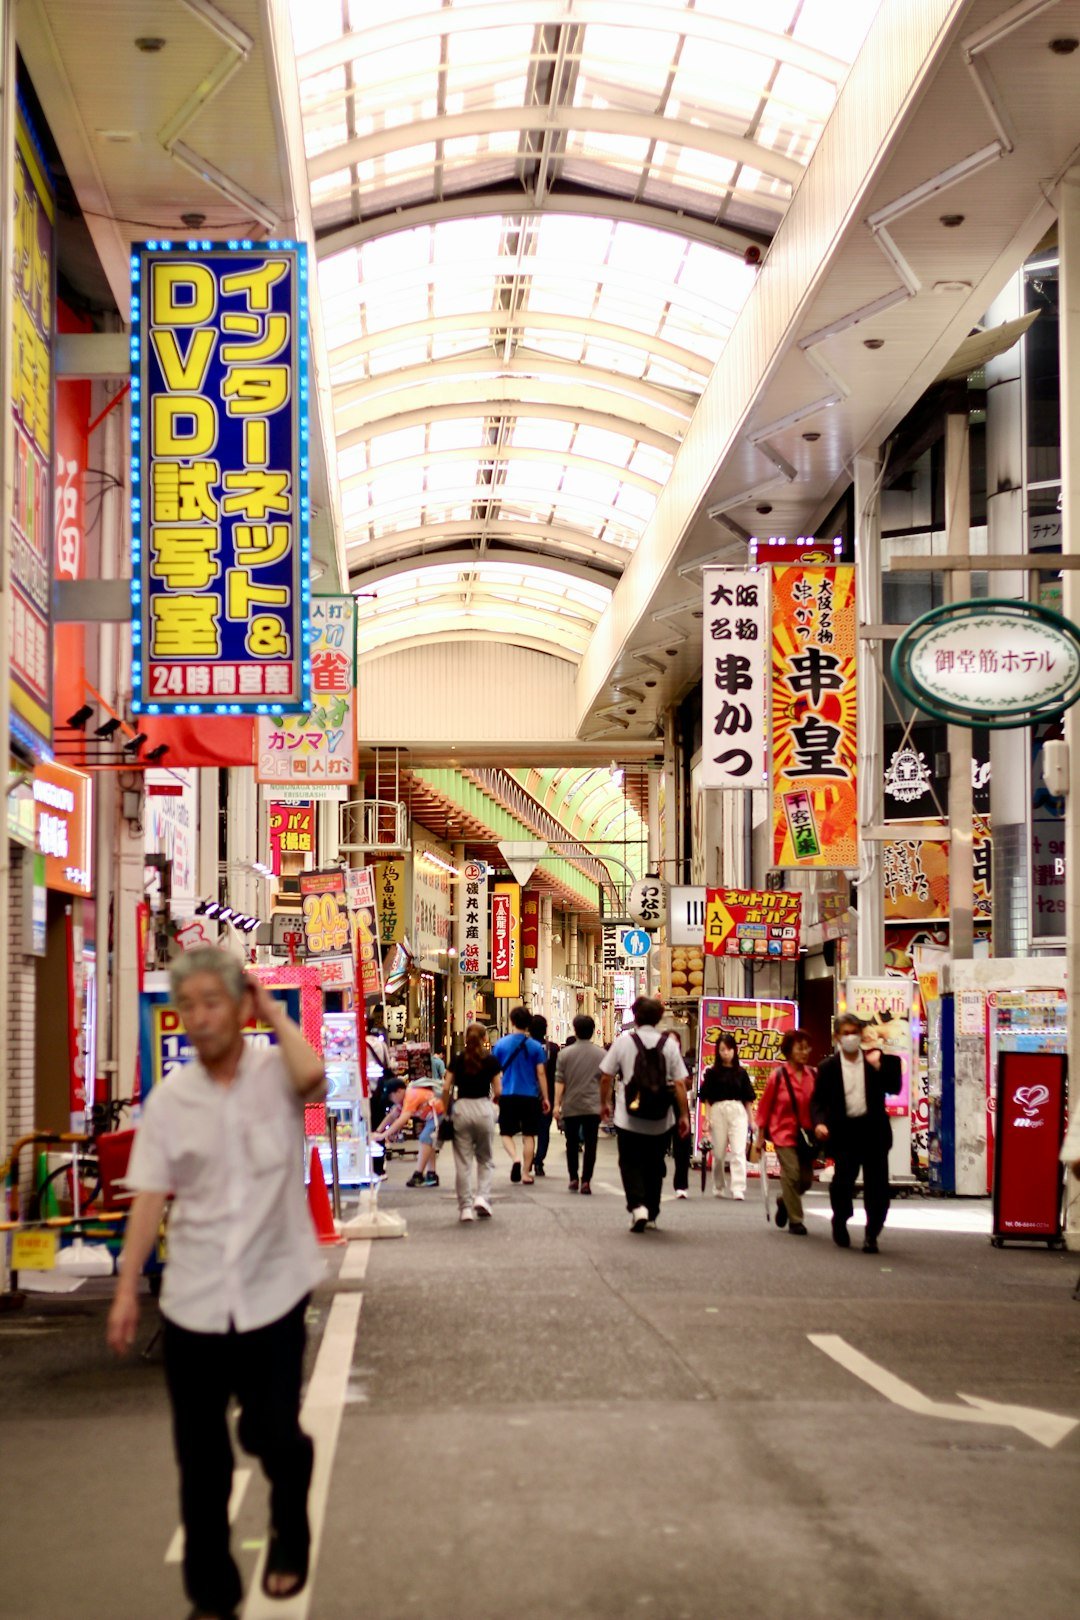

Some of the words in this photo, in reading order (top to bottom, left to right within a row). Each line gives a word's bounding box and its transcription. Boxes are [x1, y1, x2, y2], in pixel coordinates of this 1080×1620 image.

[150, 260, 222, 661] DVD試写室
[221, 259, 291, 659] インターネット&
[710, 584, 759, 608] 大阪
[793, 579, 814, 641] 串かつ
[817, 578, 834, 645] 大阪名物
[710, 617, 759, 641] 名物
[935, 649, 1057, 673] 御堂筋ホテル
[151, 664, 291, 695] 24時間営業
[713, 653, 753, 777] 串かつ
[783, 647, 850, 779] 串皇
[260, 755, 288, 776] 2F
[787, 794, 818, 856] 千客万来
[303, 892, 349, 935] 20%
[465, 882, 480, 939] 磯丸水産
[638, 885, 660, 921] わなか
[724, 891, 799, 909] ネットカフェ
[710, 911, 723, 936] 入口
[745, 909, 799, 925] ポパイ
[308, 931, 348, 952] OFF
[603, 943, 617, 971] FREE
